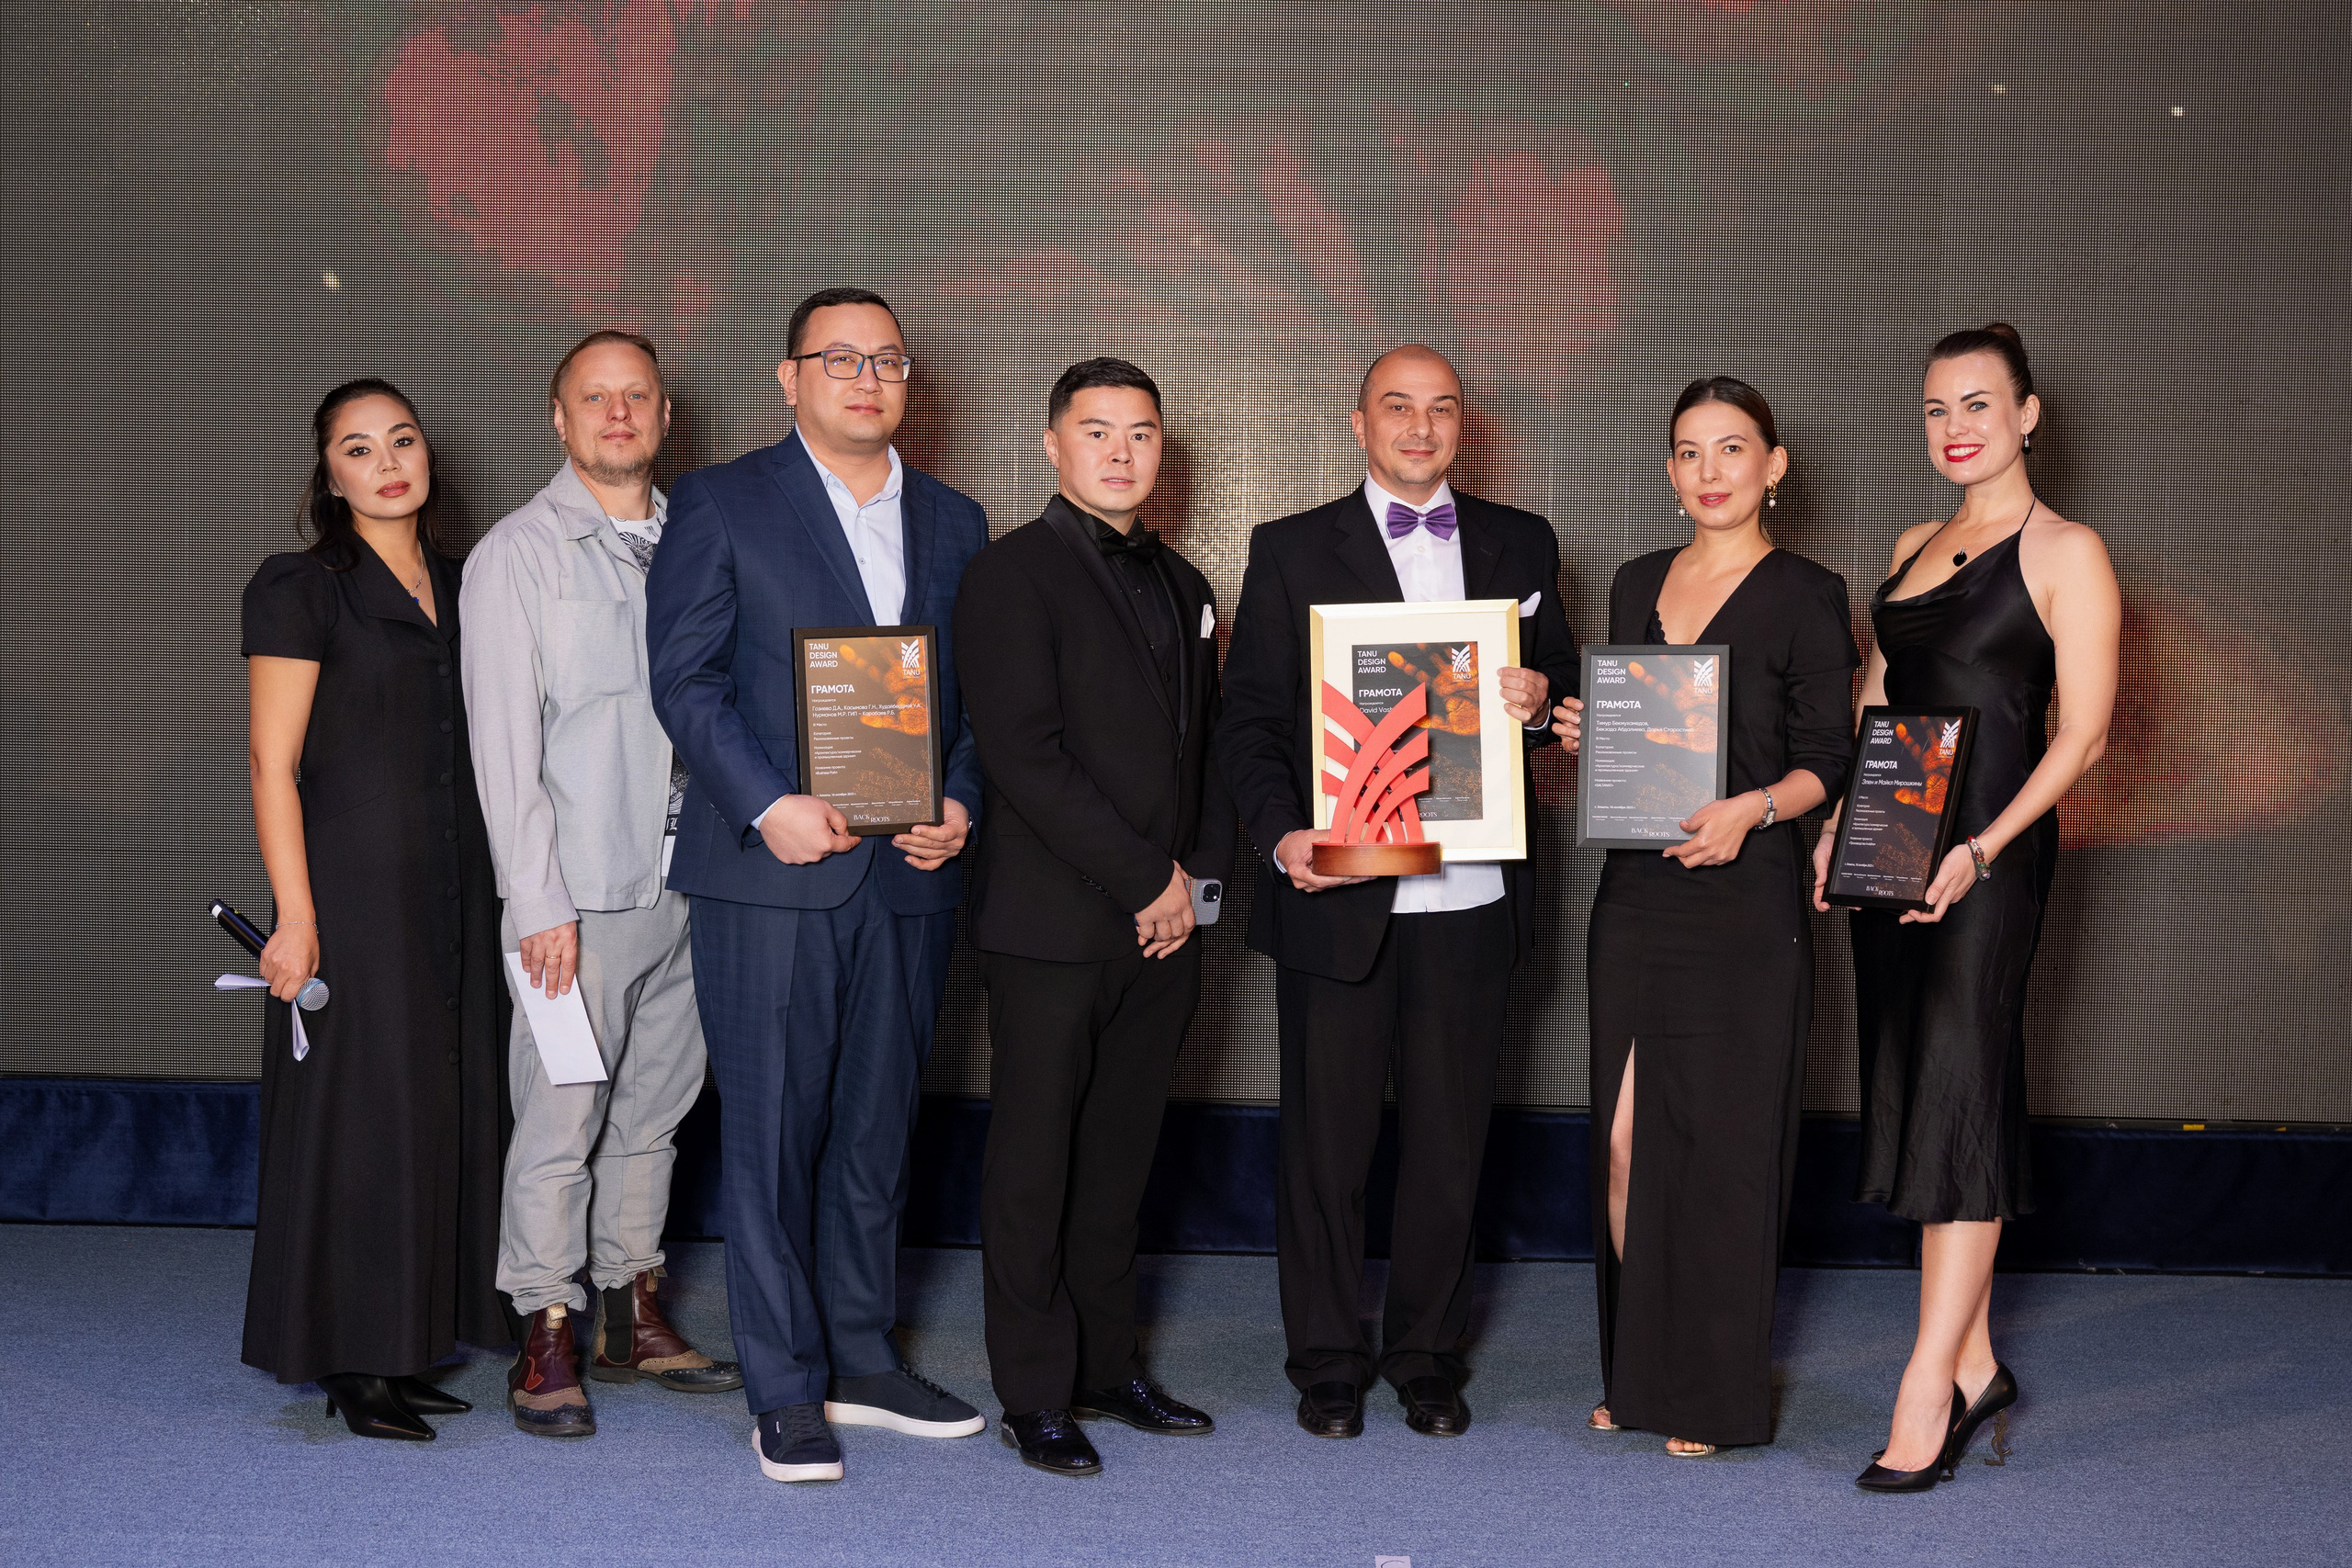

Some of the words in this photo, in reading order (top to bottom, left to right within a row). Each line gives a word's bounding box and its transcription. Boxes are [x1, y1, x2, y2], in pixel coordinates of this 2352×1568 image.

[809, 651, 838, 660] DESIGN
[809, 660, 838, 668] AWARD
[1358, 658, 1386, 666] DESIGN
[1596, 676, 1626, 684] AWARD
[811, 683, 854, 694] ГРАМОТА
[1359, 688, 1403, 698] ГРАМОТА
[1596, 700, 1642, 709] ГРАМОТА
[1865, 760, 1898, 769] ГРАМОТА
